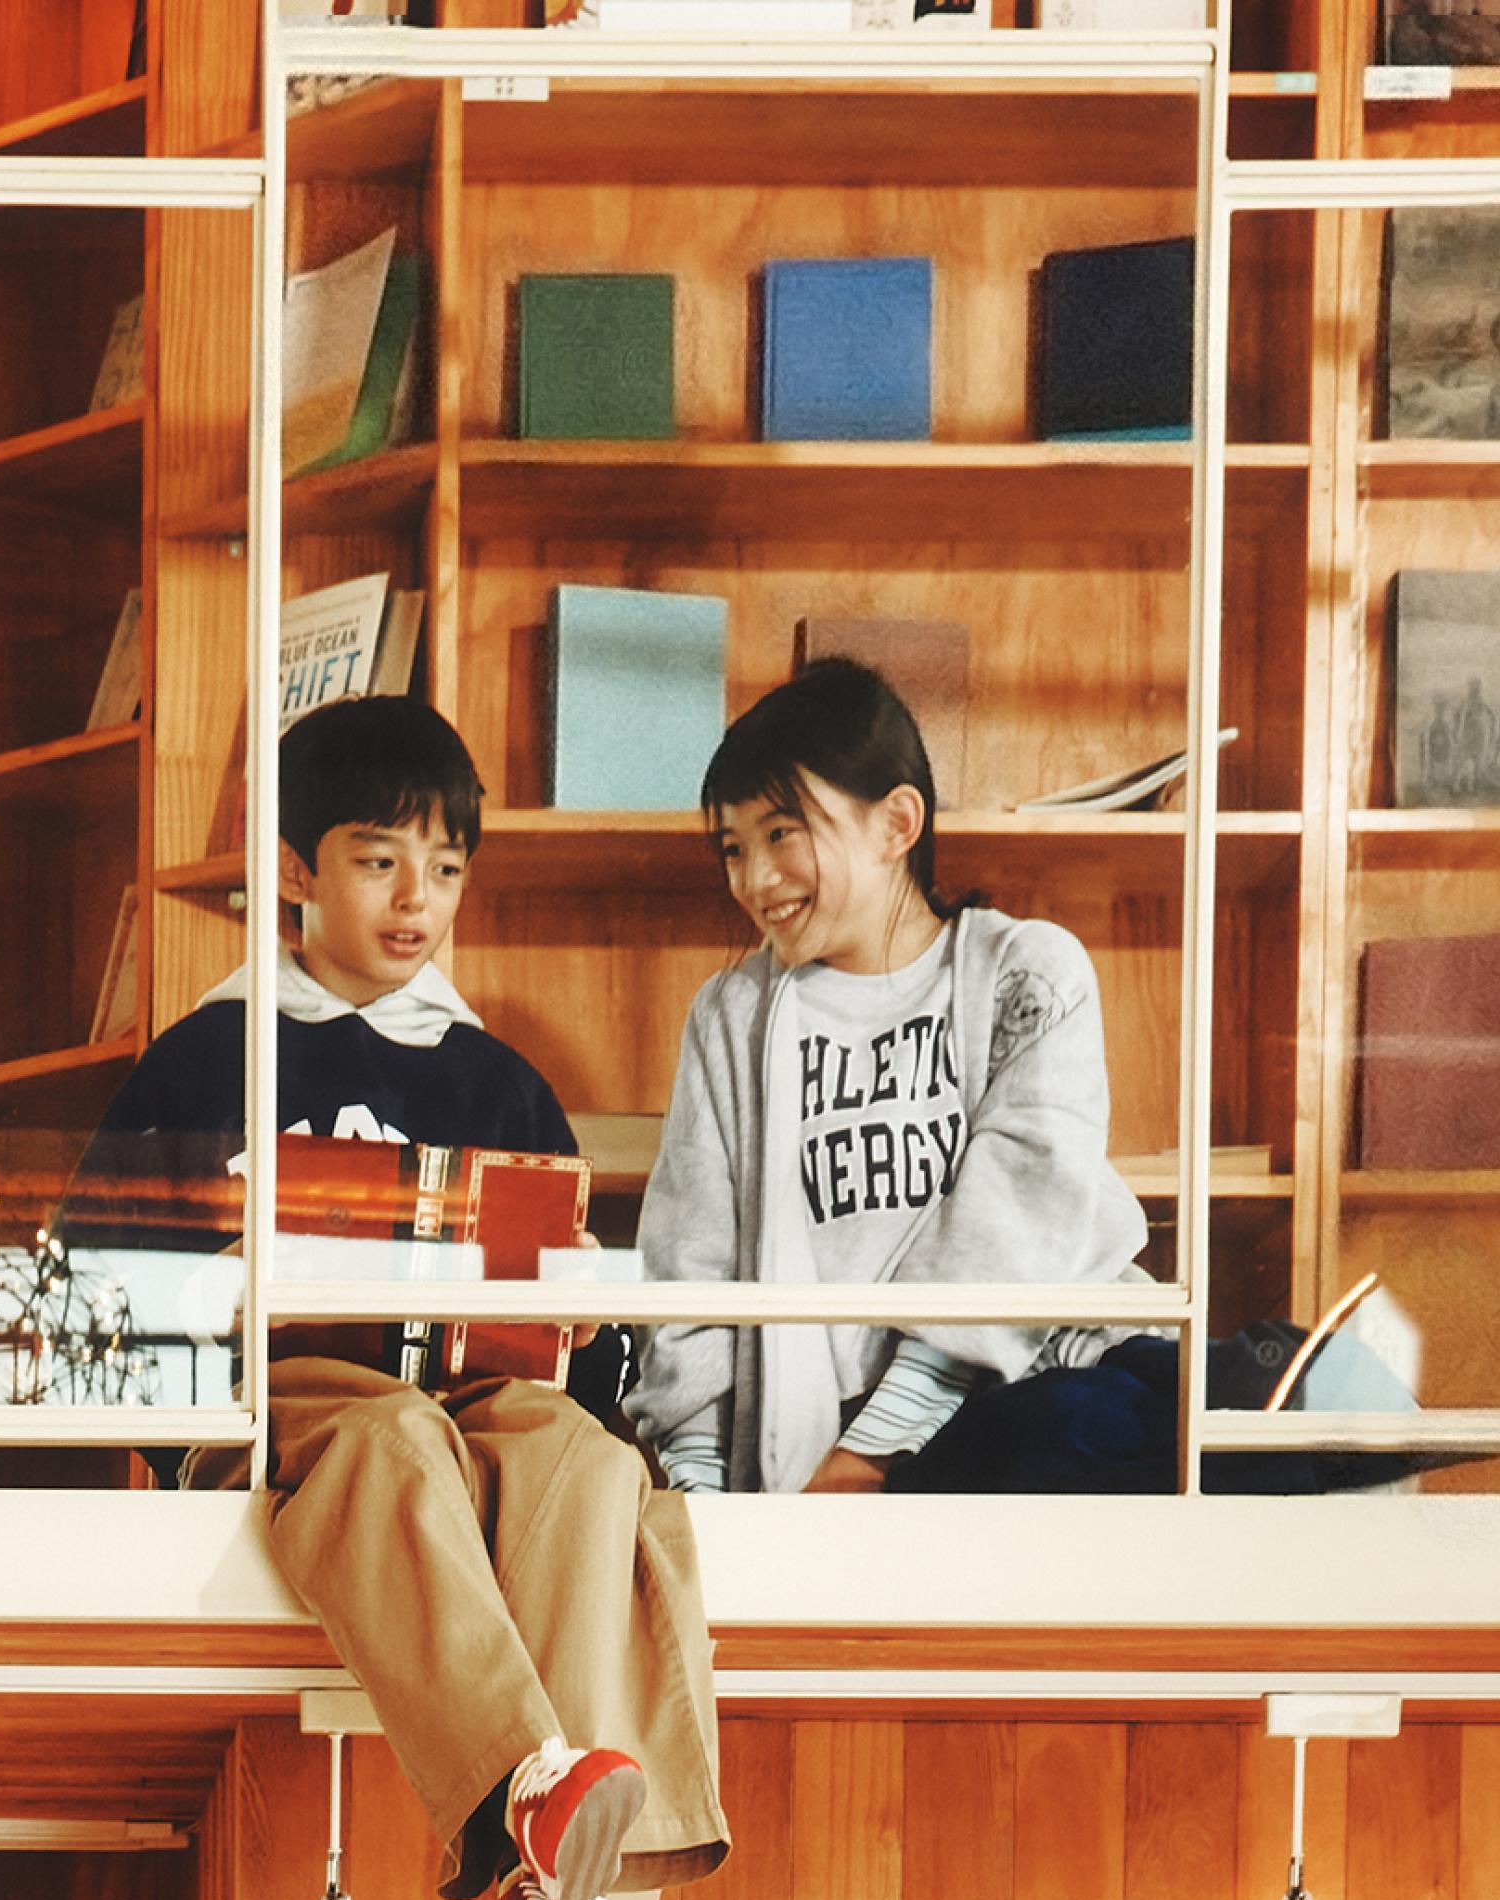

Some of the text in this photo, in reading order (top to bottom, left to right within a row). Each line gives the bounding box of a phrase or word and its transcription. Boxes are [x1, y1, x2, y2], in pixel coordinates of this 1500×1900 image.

[279, 640, 309, 667] BLUE
[315, 628, 359, 656] OCEAN
[279, 650, 362, 712] HIFT
